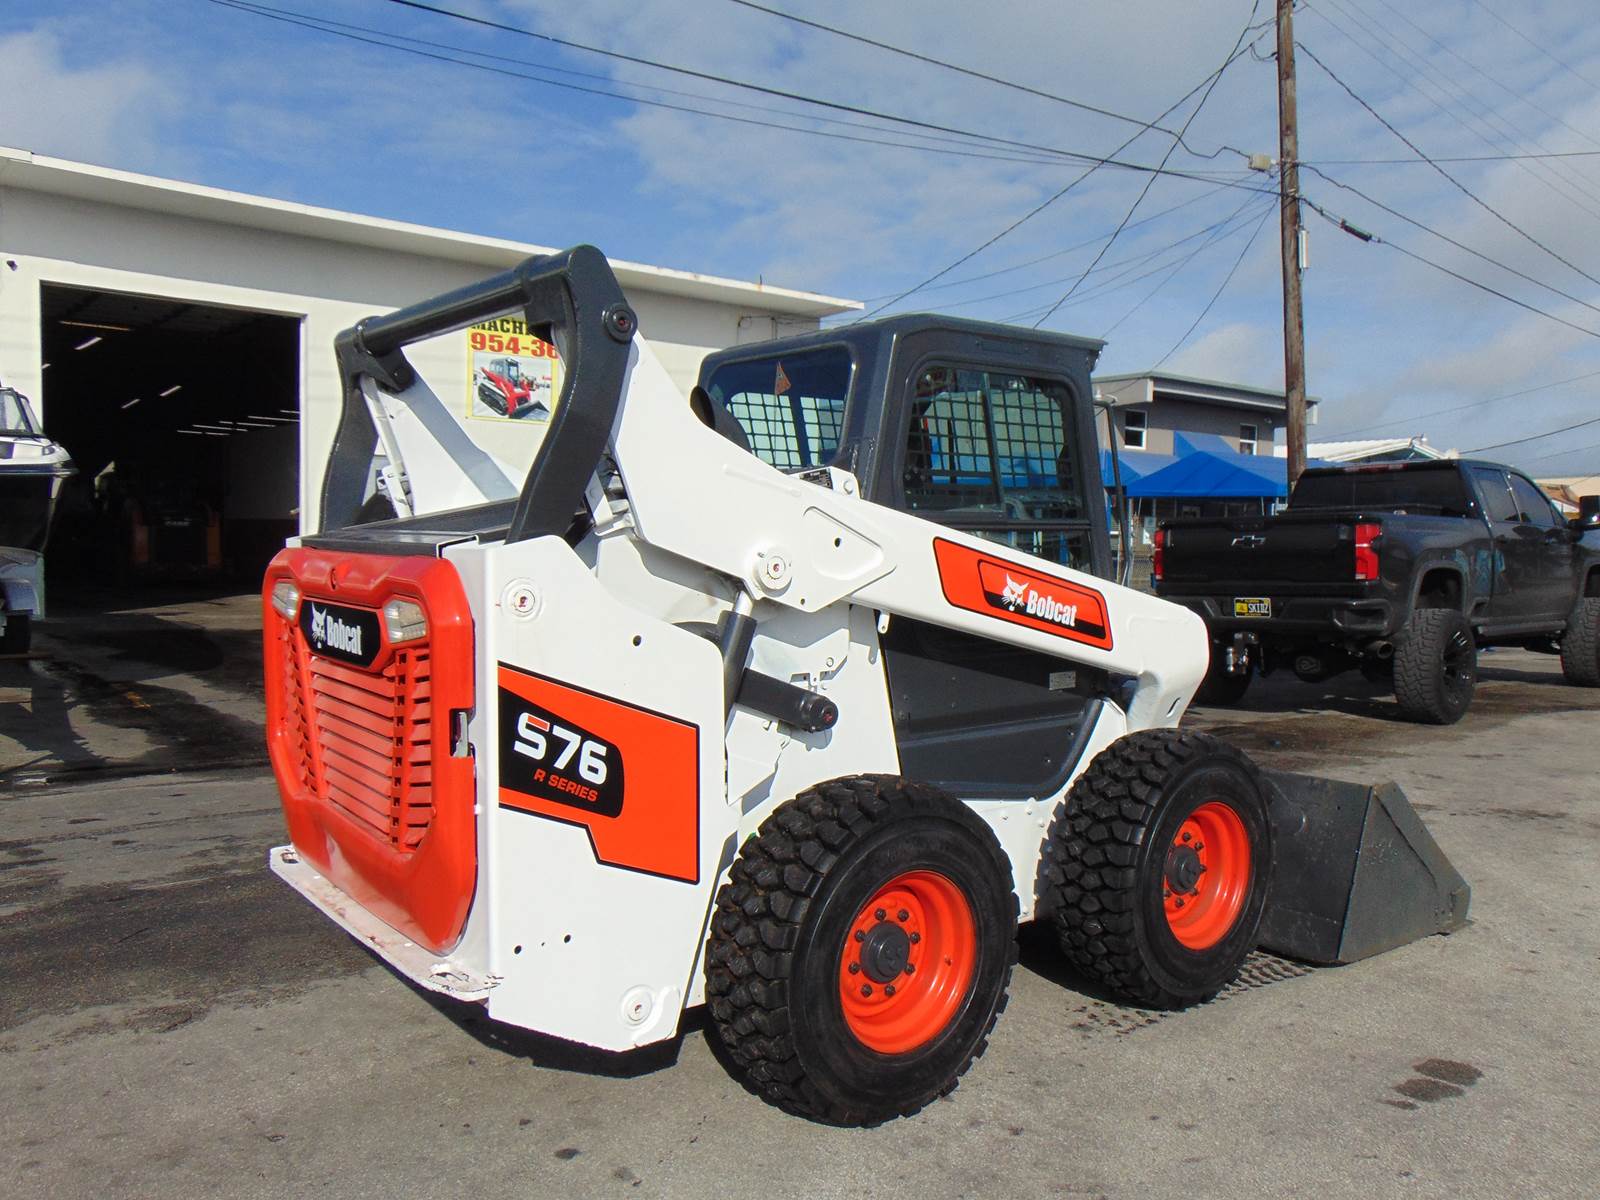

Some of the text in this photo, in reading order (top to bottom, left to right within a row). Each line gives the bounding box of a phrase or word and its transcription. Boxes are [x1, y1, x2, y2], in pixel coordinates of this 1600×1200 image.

[1026, 590, 1077, 627] Bobcat
[326, 615, 363, 656] Bobcat
[513, 712, 608, 785] S76
[533, 768, 598, 802] R SERIES
